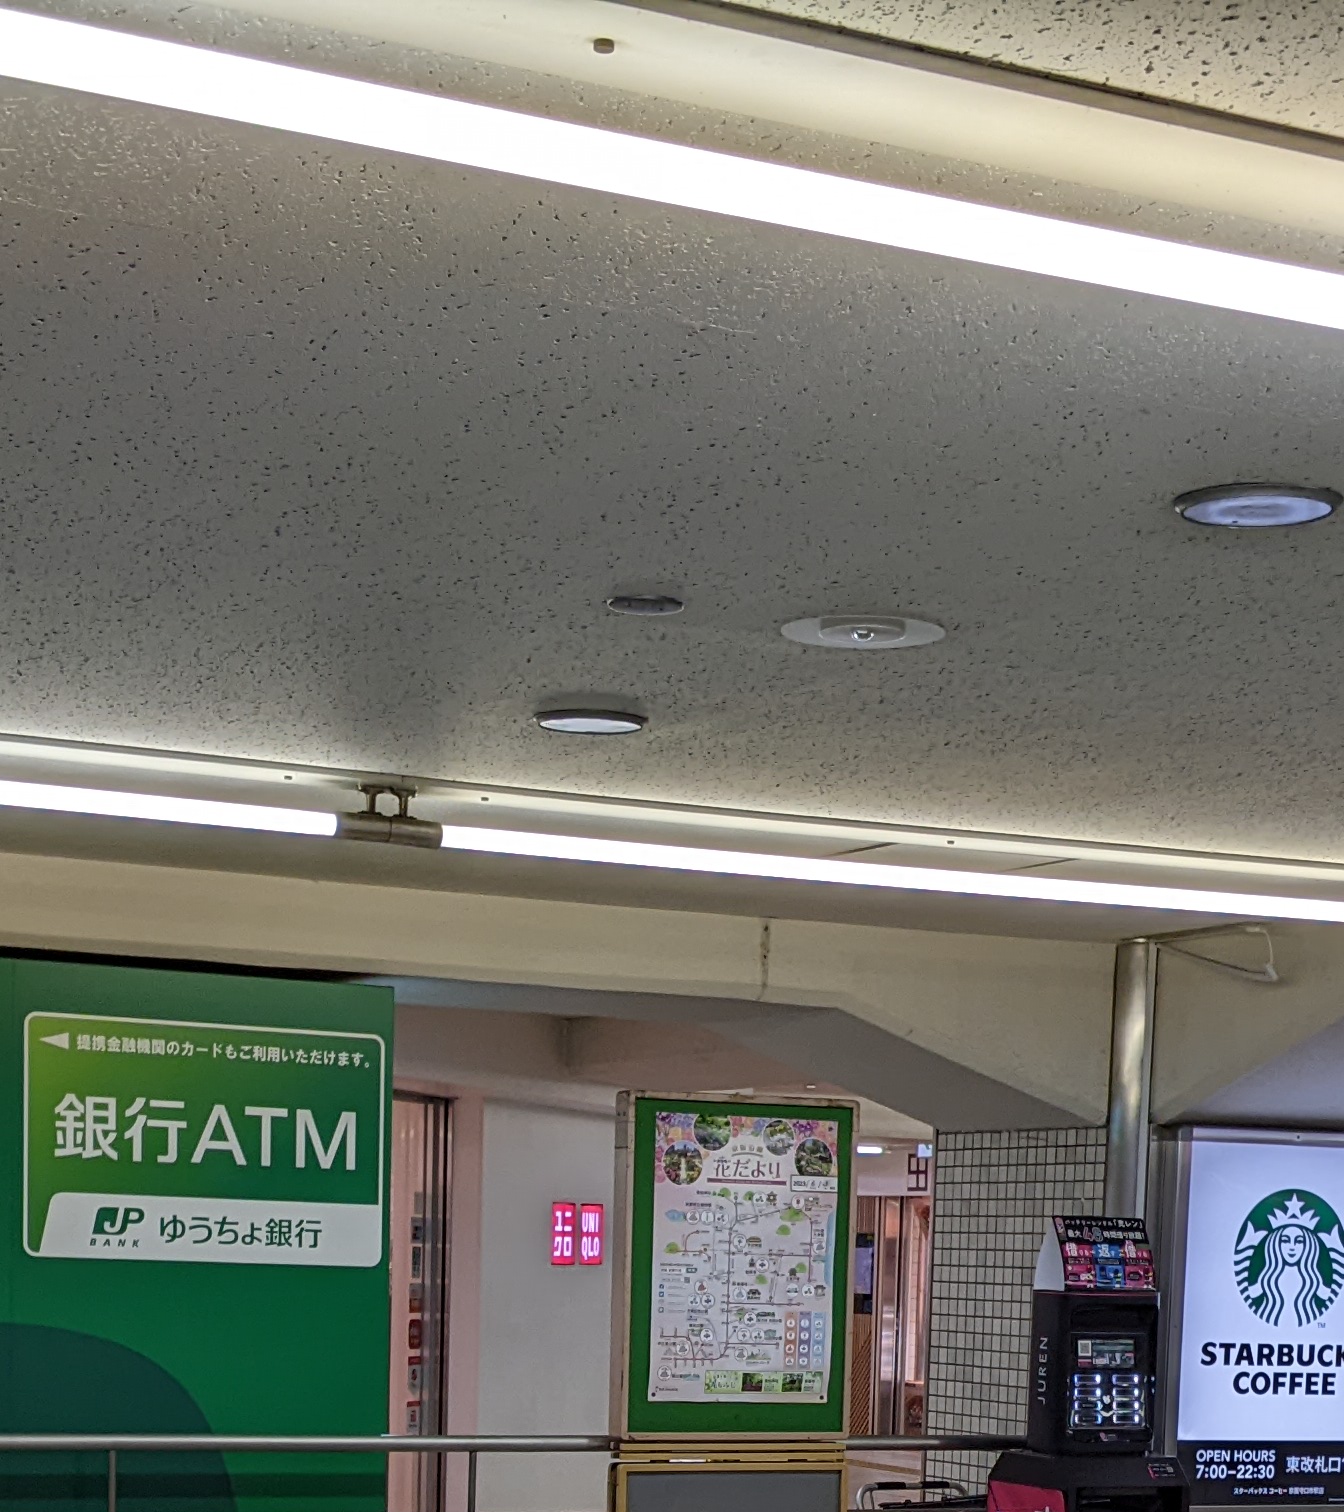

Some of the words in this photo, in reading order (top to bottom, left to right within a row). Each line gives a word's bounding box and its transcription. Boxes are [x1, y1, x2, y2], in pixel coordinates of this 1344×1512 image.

[76, 1034, 371, 1068] 提携金融機関のカードもご利用いただけます。
[54, 1093, 357, 1171] 銀行ATM
[92, 1206, 145, 1235] JP
[159, 1214, 323, 1249] ゆうちょ銀行
[554, 1210, 572, 1232] ユニ
[581, 1212, 599, 1233] UNI
[89, 1237, 141, 1248] BANK
[553, 1236, 572, 1257] クロ
[581, 1236, 600, 1260] QLO
[1037, 1337, 1049, 1405] JUREN
[1233, 1371, 1337, 1396] COFFEE
[1196, 1449, 1231, 1463] OPEN
[1234, 1449, 1276, 1463] HOURS
